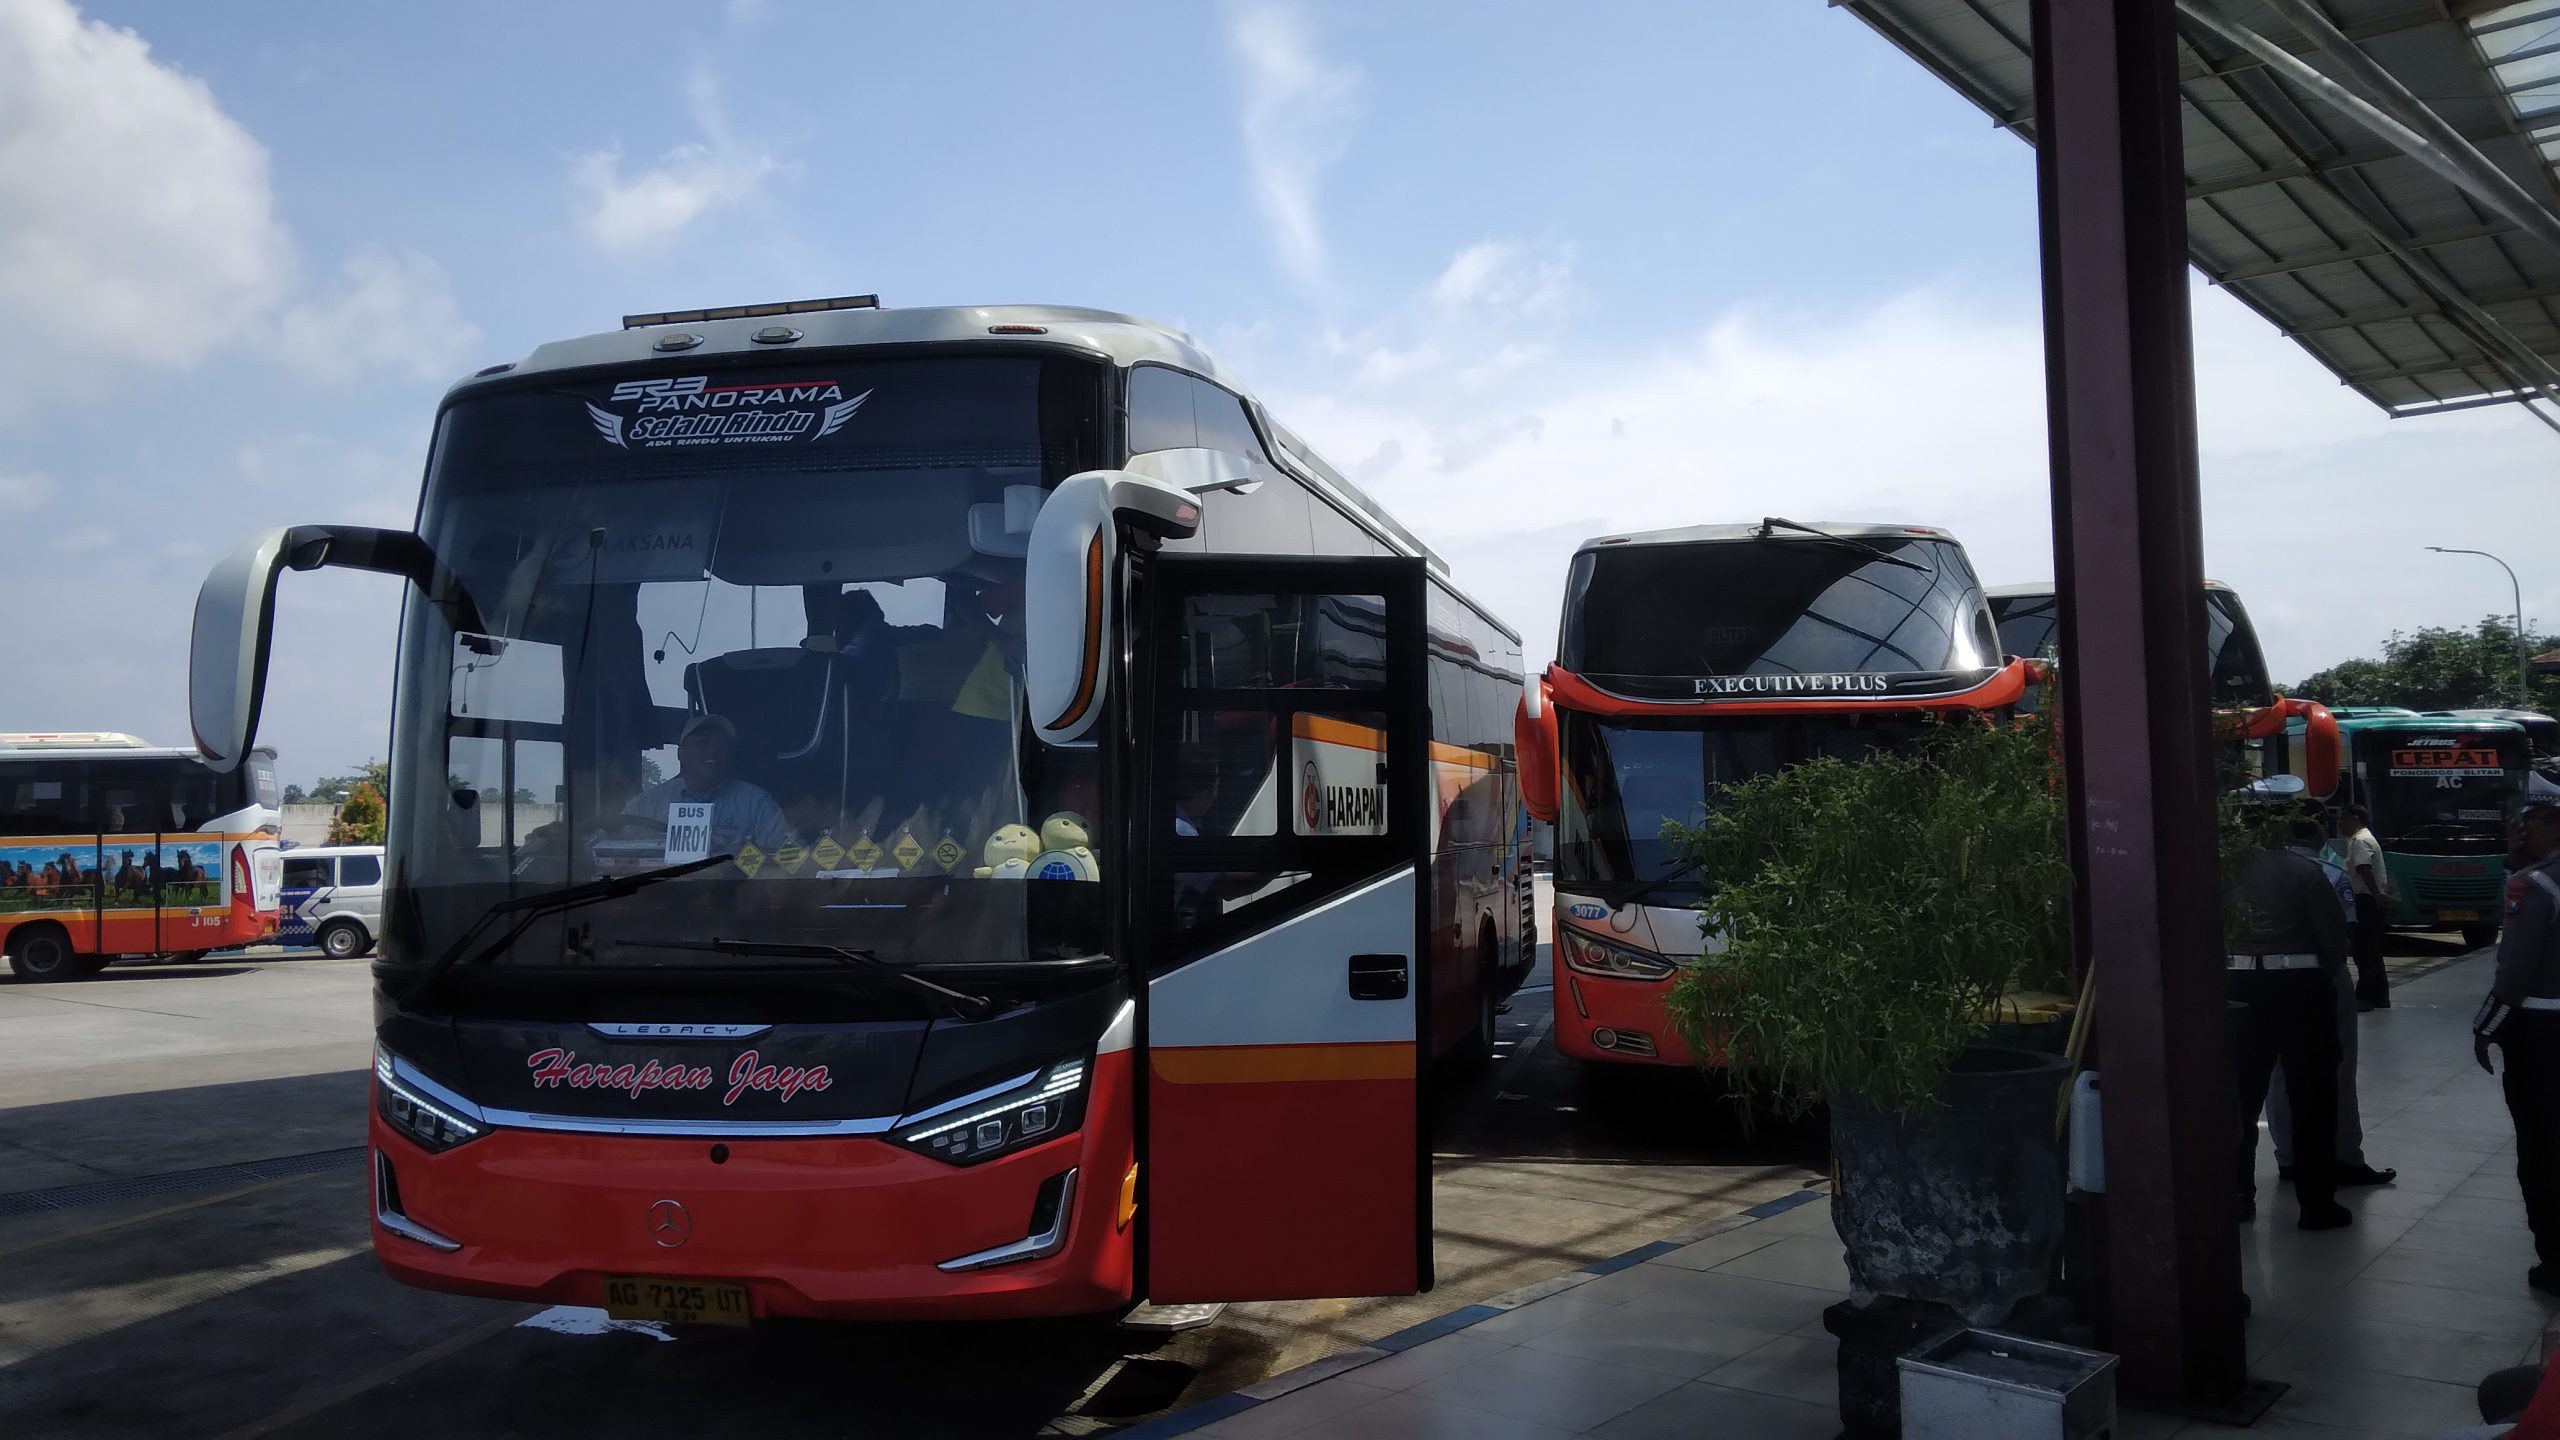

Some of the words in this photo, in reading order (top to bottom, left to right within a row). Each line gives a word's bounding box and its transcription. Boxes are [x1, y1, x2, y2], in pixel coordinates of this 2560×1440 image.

[638, 385, 843, 413] PANORAMA
[629, 413, 724, 440] Selalu
[722, 410, 815, 435] Rindu
[677, 437, 719, 446] RINDU
[723, 435, 794, 444] UNTUKMU
[1694, 675, 1825, 694] EXECUTIVE
[1830, 674, 1888, 692] PLUS
[2395, 751, 2494, 765] CEPAT
[2436, 776, 2463, 788] AC
[678, 807, 705, 818] BUS
[1326, 785, 1384, 827] HARAPAN
[668, 824, 709, 853] MR01
[1574, 905, 1600, 918] 3077
[191, 917, 199, 927] J
[203, 916, 221, 927] 105
[617, 1025, 738, 1035] LEGACY
[527, 1048, 712, 1099] Harapan
[723, 1050, 833, 1106] Jaya
[608, 1282, 638, 1305] AG
[649, 1284, 706, 1310] 7125
[716, 1287, 742, 1313] UT
